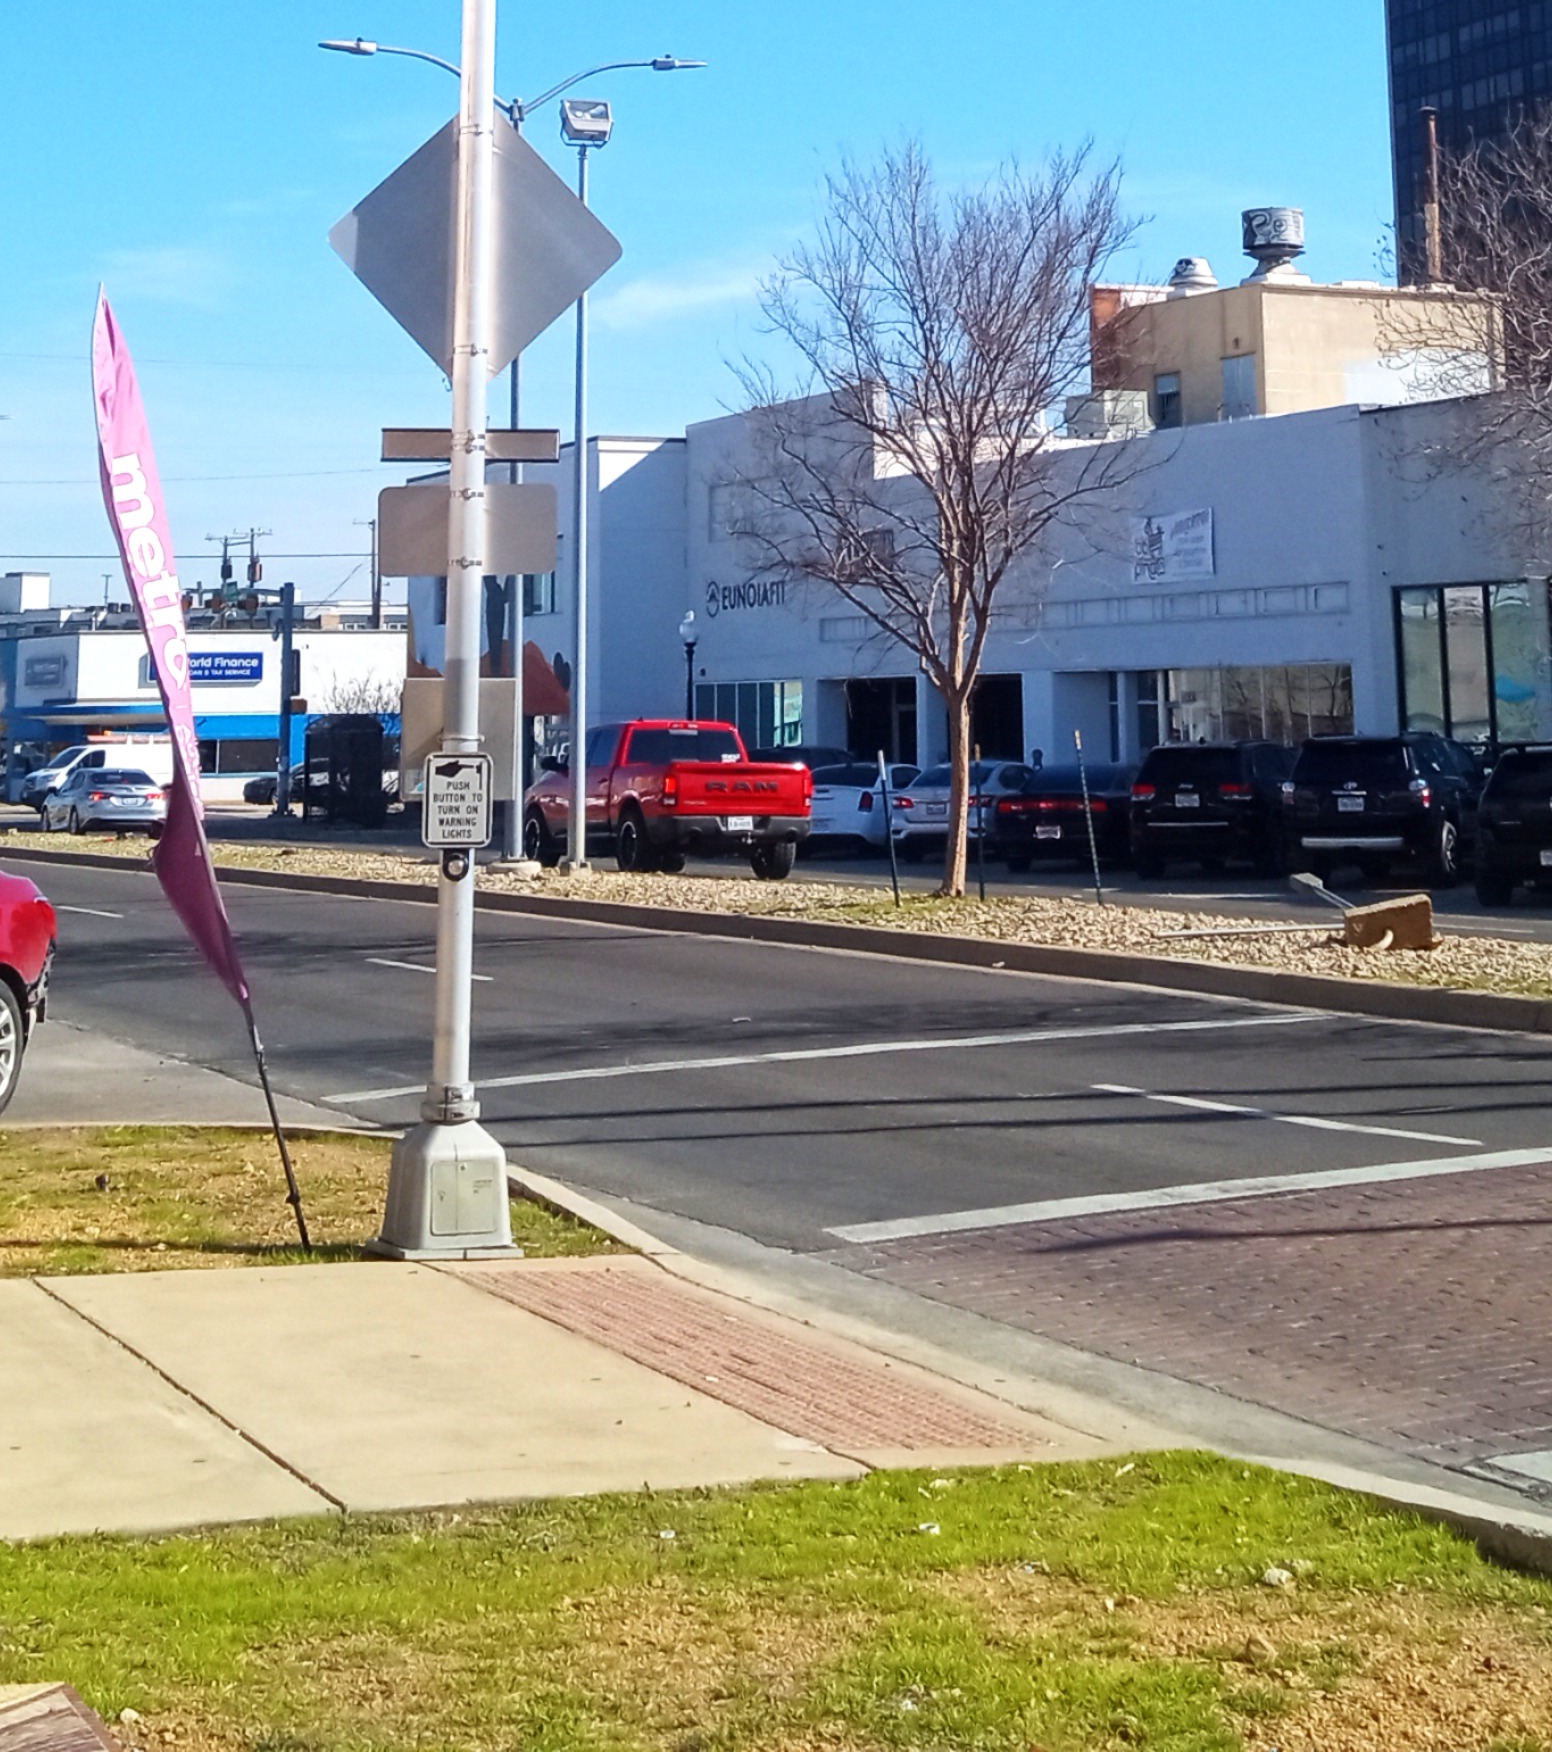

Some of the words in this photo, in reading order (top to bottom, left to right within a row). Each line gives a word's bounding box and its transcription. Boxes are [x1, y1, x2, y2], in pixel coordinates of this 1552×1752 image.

[111, 452, 188, 691] metro
[188, 656, 213, 668] orld
[214, 656, 259, 668] Finance
[447, 781, 470, 791] PUSH
[705, 781, 779, 793] RAM
[433, 793, 466, 803] BUTTON
[471, 793, 484, 803] TO
[437, 805, 461, 815] TURN
[466, 805, 479, 815] ON
[438, 817, 477, 827] WARNING
[442, 829, 473, 839] LIGHTS
